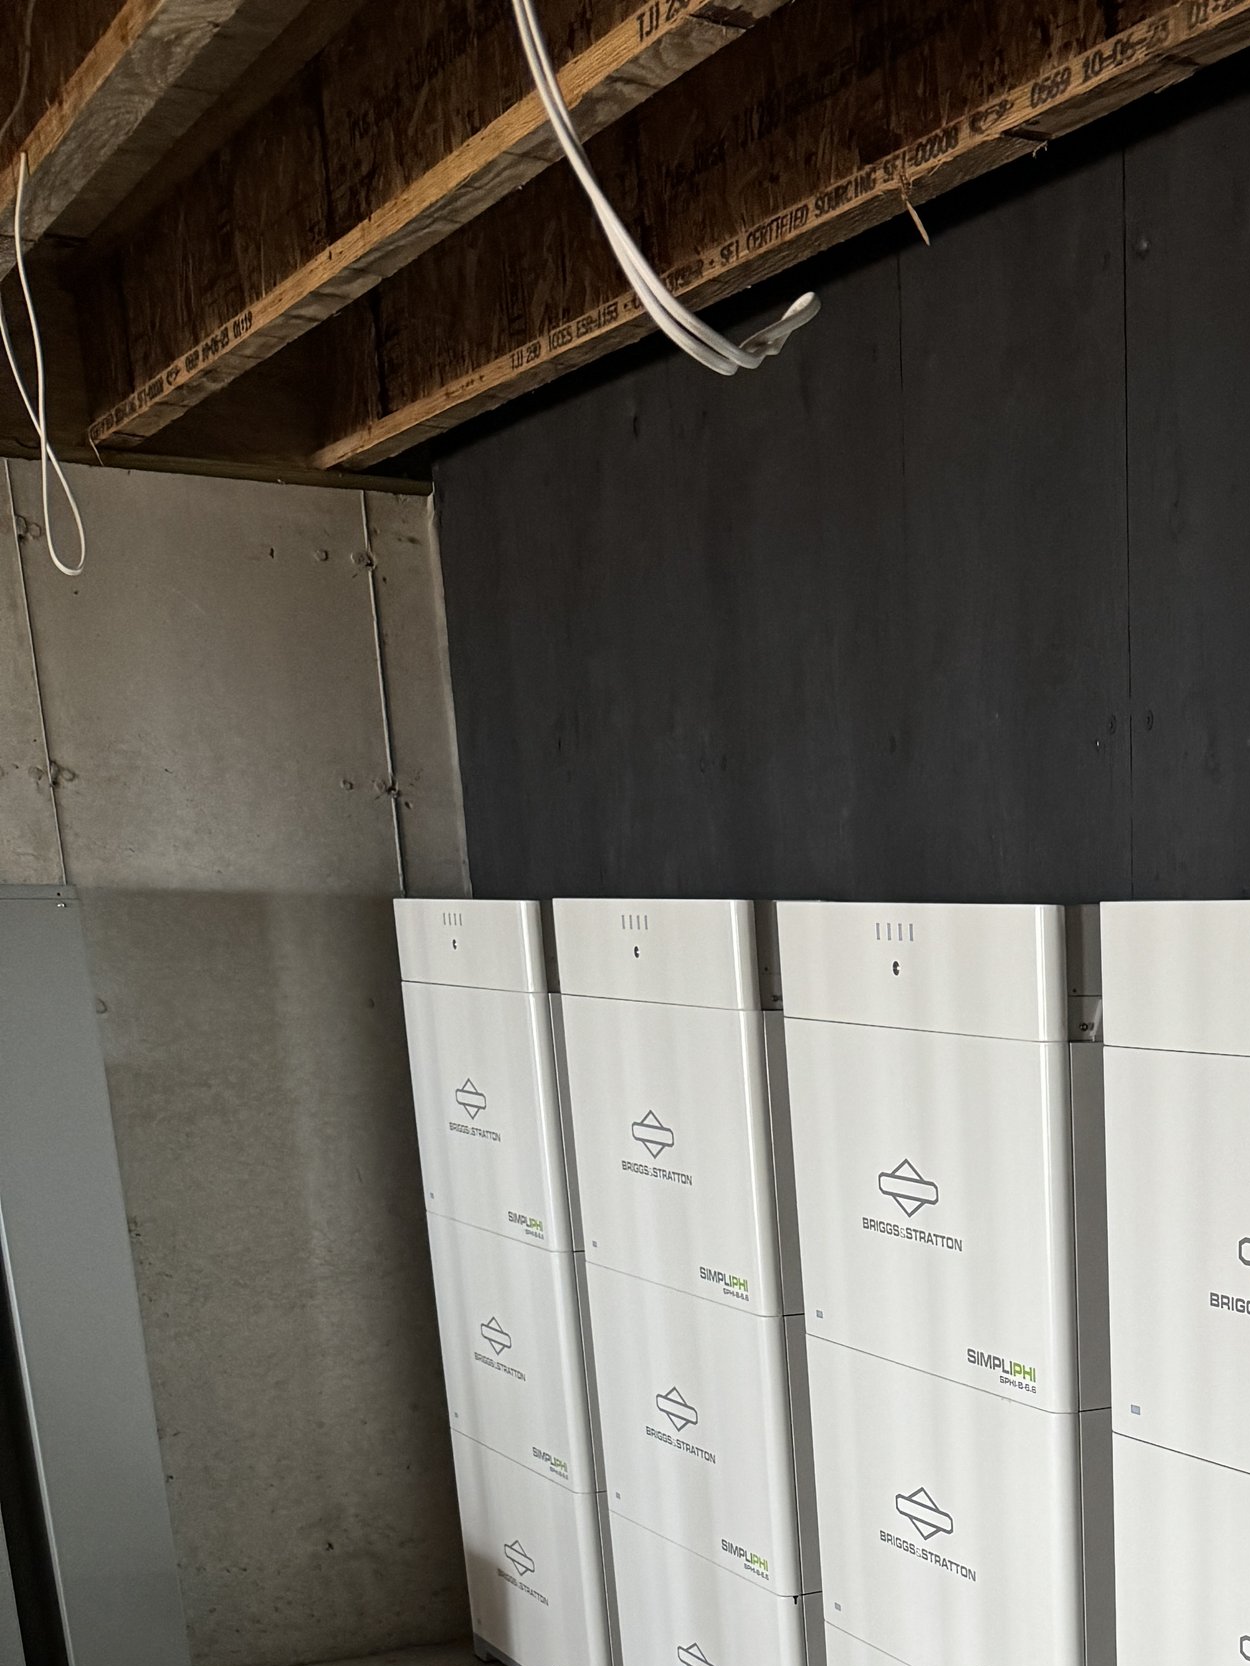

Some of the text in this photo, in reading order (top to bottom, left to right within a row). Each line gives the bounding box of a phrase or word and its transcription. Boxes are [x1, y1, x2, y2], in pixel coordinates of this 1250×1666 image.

[700, 1266, 749, 1292] SIMPLIPHI
[967, 1348, 1036, 1382] SIMPLIPHI
[721, 1538, 769, 1571] SIMPLIPHI
